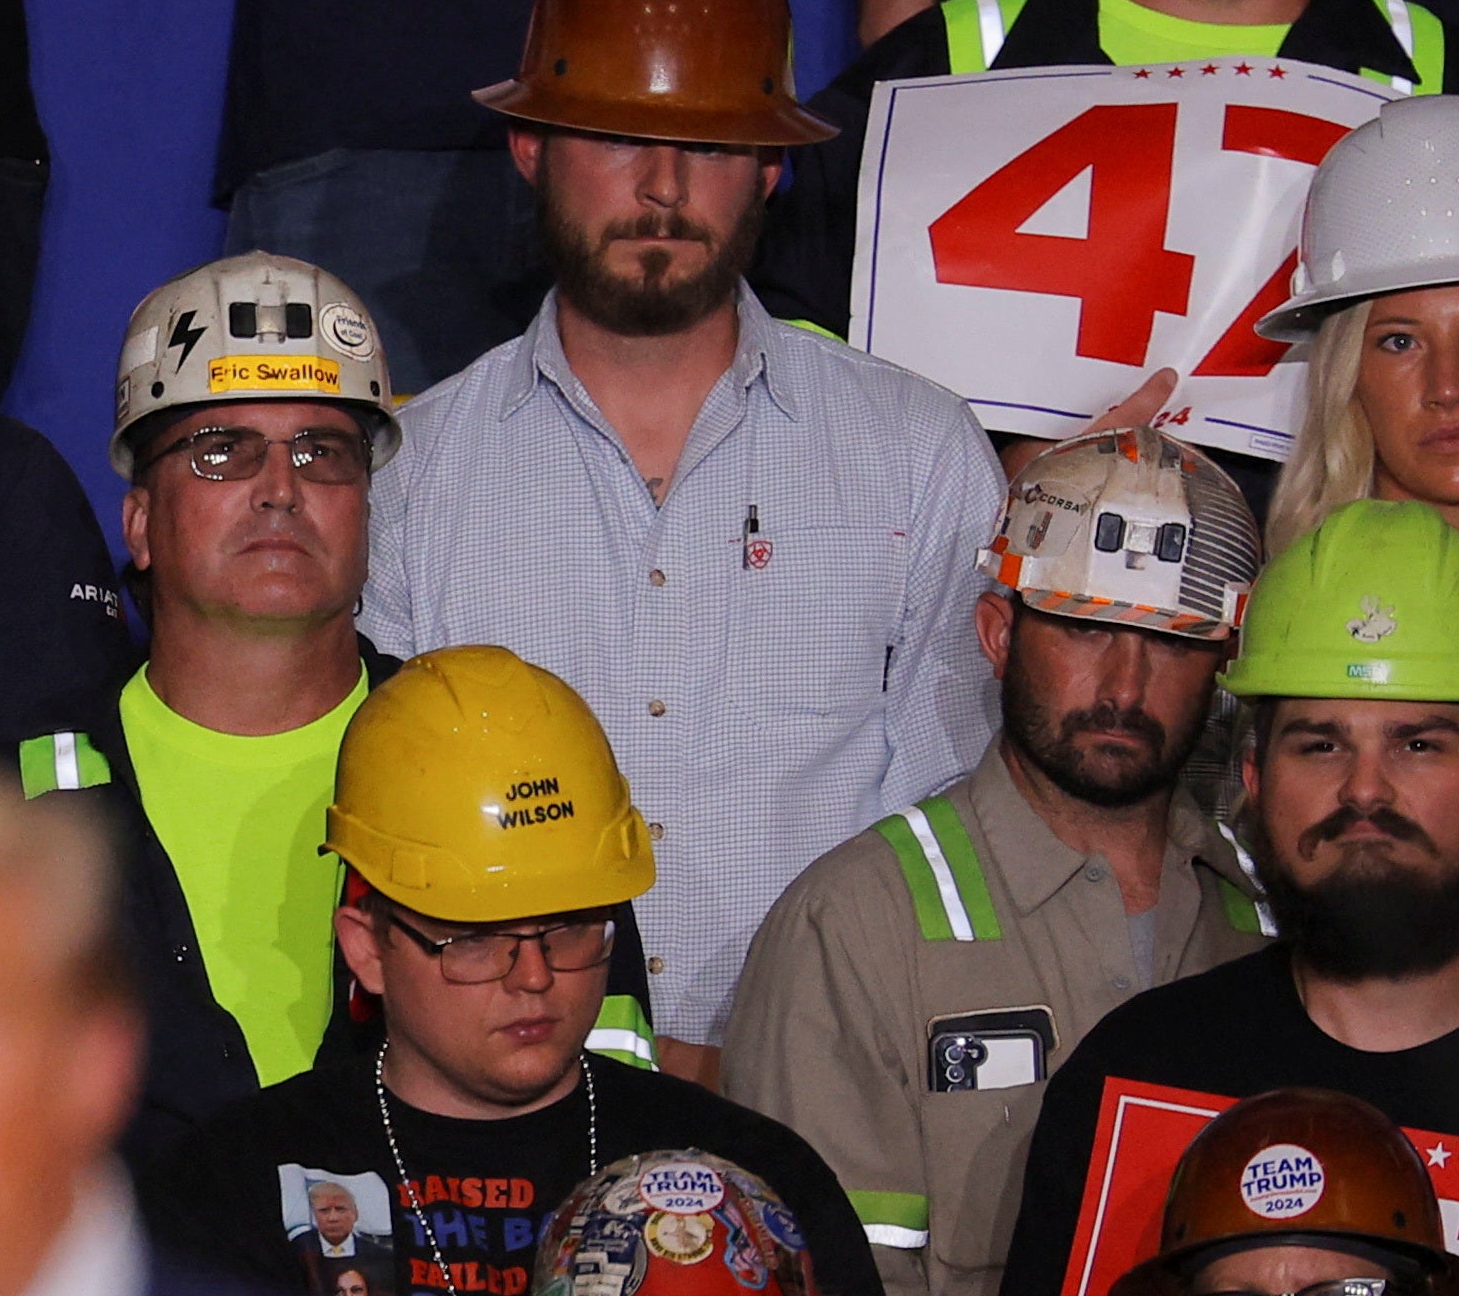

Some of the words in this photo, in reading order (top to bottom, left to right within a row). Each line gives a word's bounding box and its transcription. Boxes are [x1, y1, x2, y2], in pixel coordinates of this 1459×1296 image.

[928, 101, 1350, 378] 47
[257, 363, 338, 385] Swallow
[1040, 492, 1084, 515] CORSA
[505, 777, 559, 801] JOHN
[497, 801, 574, 830] WILSON
[649, 1170, 713, 1183] TEAM
[1247, 1157, 1313, 1179] TEAM
[397, 1175, 535, 1209] RAISED
[642, 1179, 723, 1194] TRUMP
[1242, 1172, 1322, 1196] TRUMP
[665, 1197, 704, 1208] 2024
[1266, 1197, 1304, 1213] 2024
[404, 1209, 490, 1251] THE
[409, 1258, 529, 1296] FAILED
